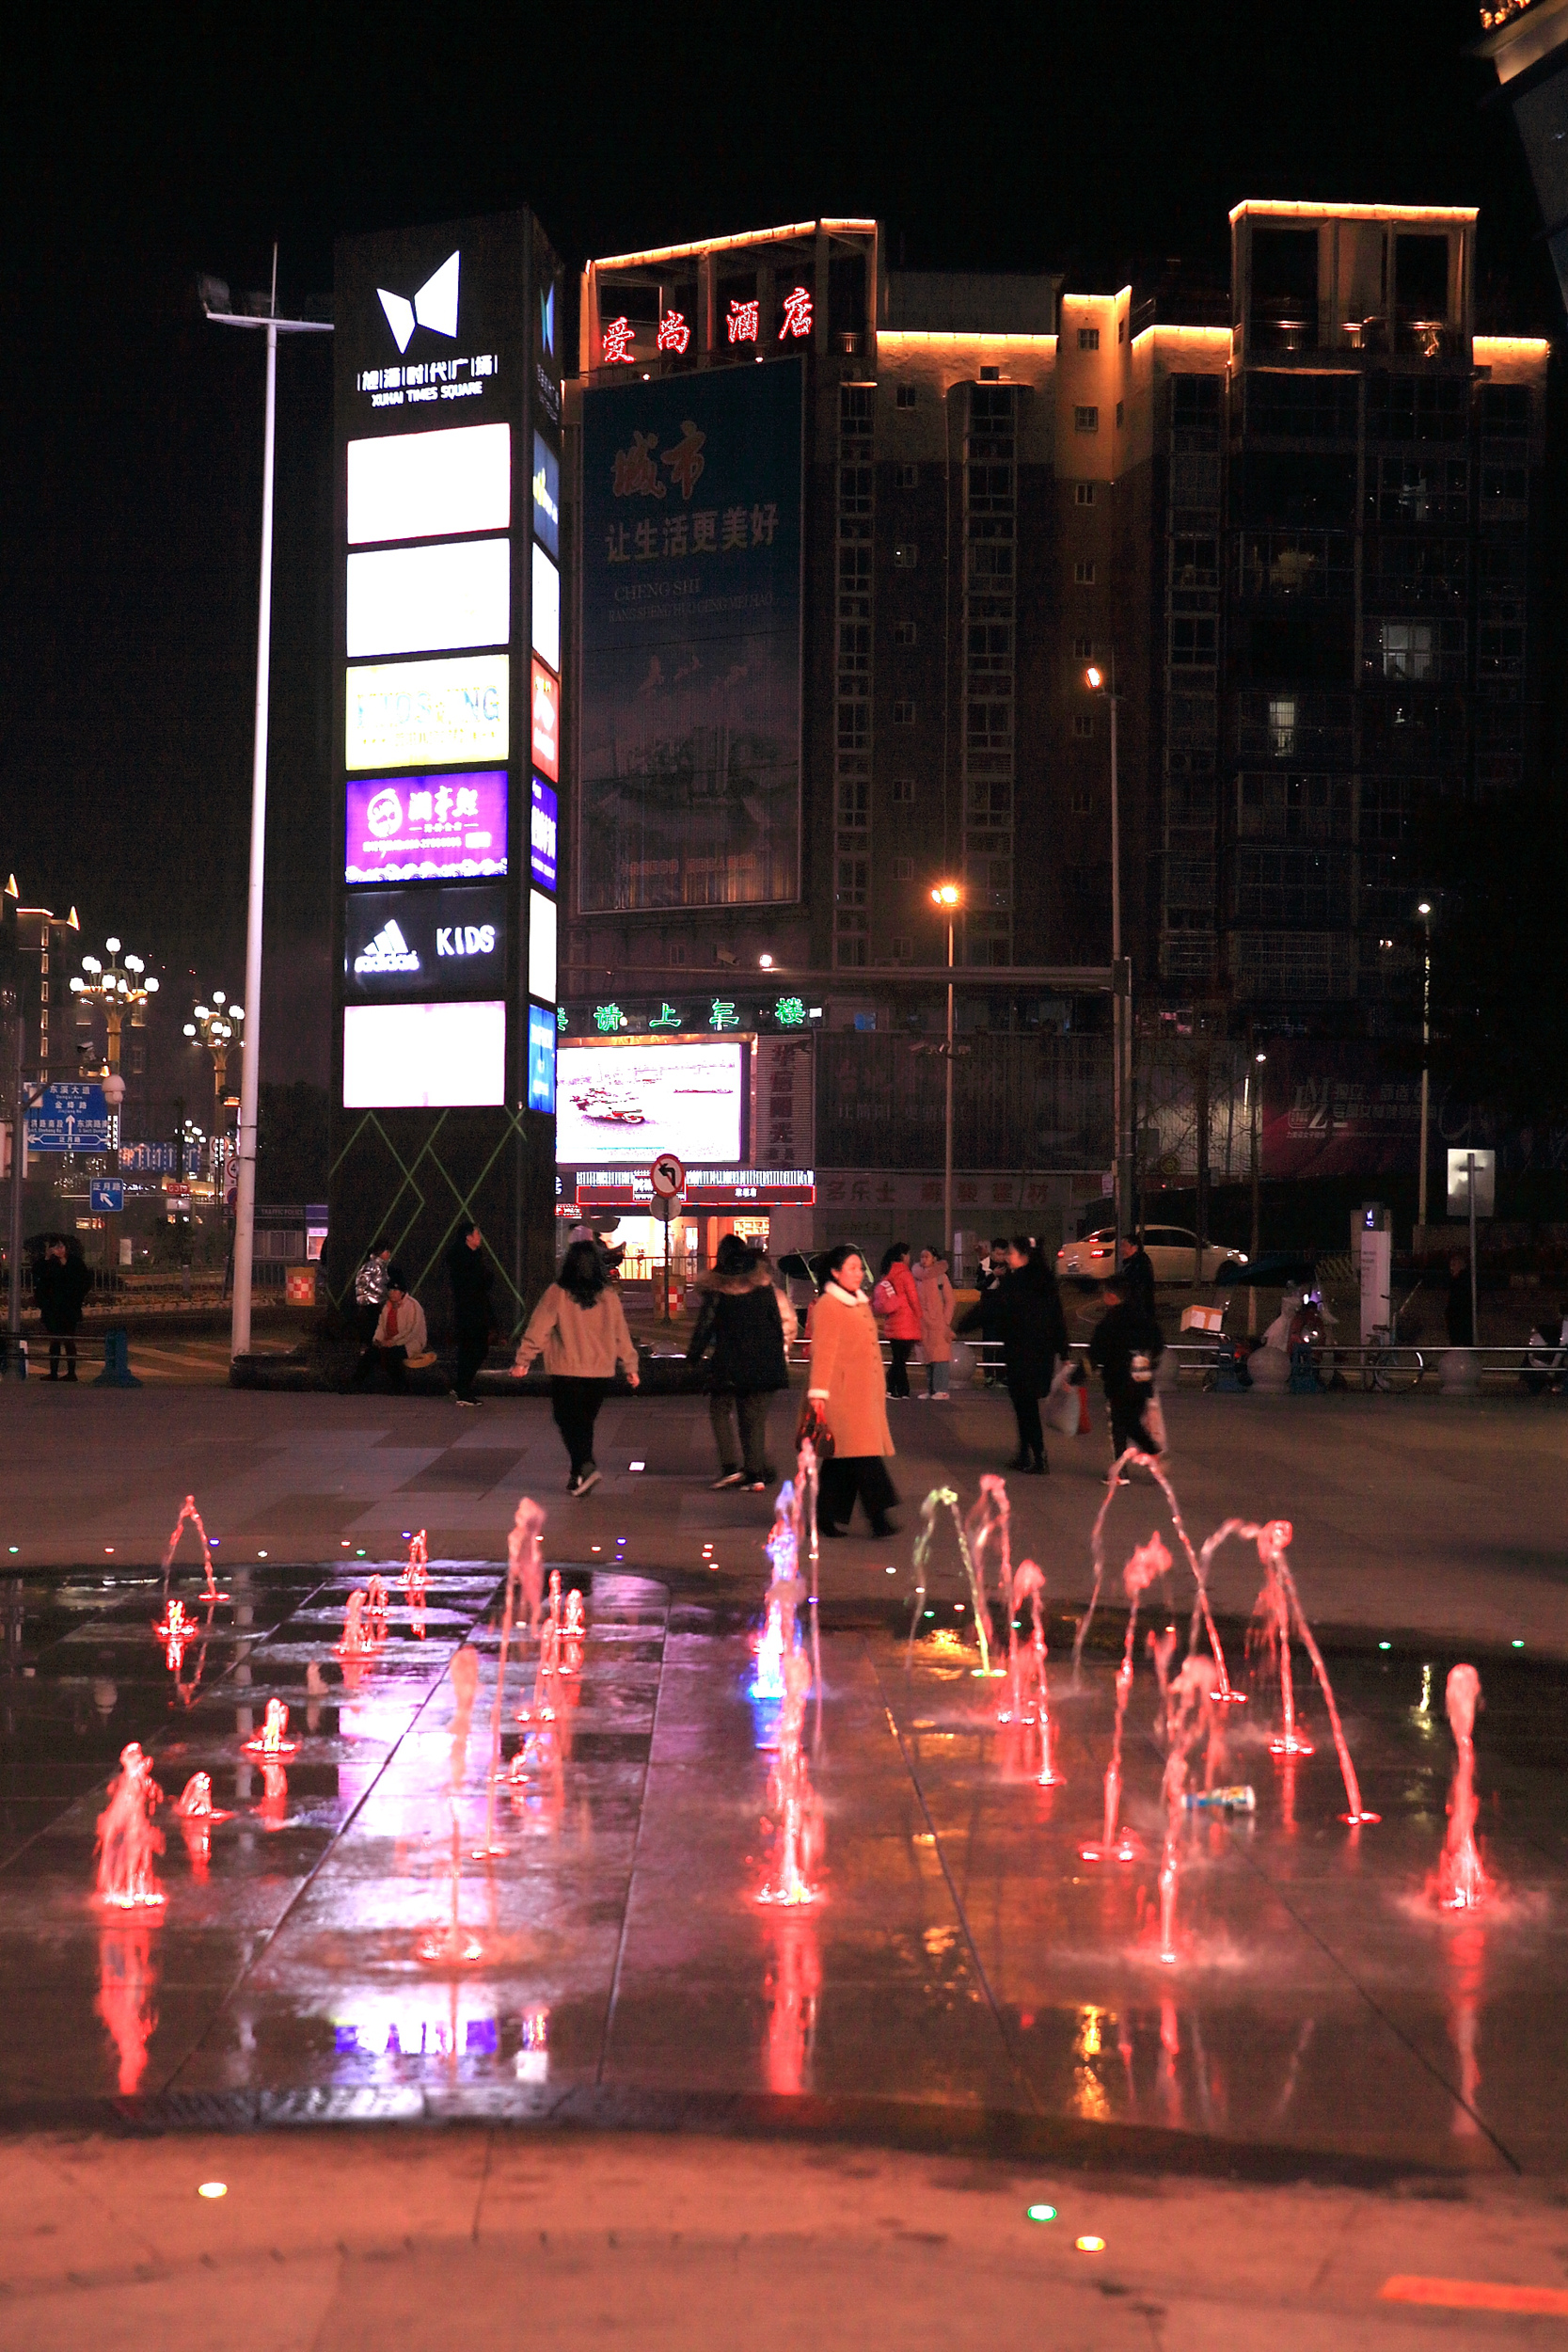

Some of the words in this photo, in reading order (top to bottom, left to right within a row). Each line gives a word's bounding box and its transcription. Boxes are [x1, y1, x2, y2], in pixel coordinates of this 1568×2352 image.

[602, 286, 814, 364] 爱尚酒店
[406, 387, 438, 403] TIMES
[440, 381, 483, 400] SQUARE
[611, 420, 705, 501] 城市
[605, 503, 780, 563] 让生活更美好
[613, 580, 671, 602] CHENG
[673, 578, 702, 596] SHI
[436, 925, 496, 956] KIDS
[50, 1086, 91, 1095] 东溪大道
[92, 1182, 121, 1191] 泛月路
[167, 1184, 189, 1194] G319
